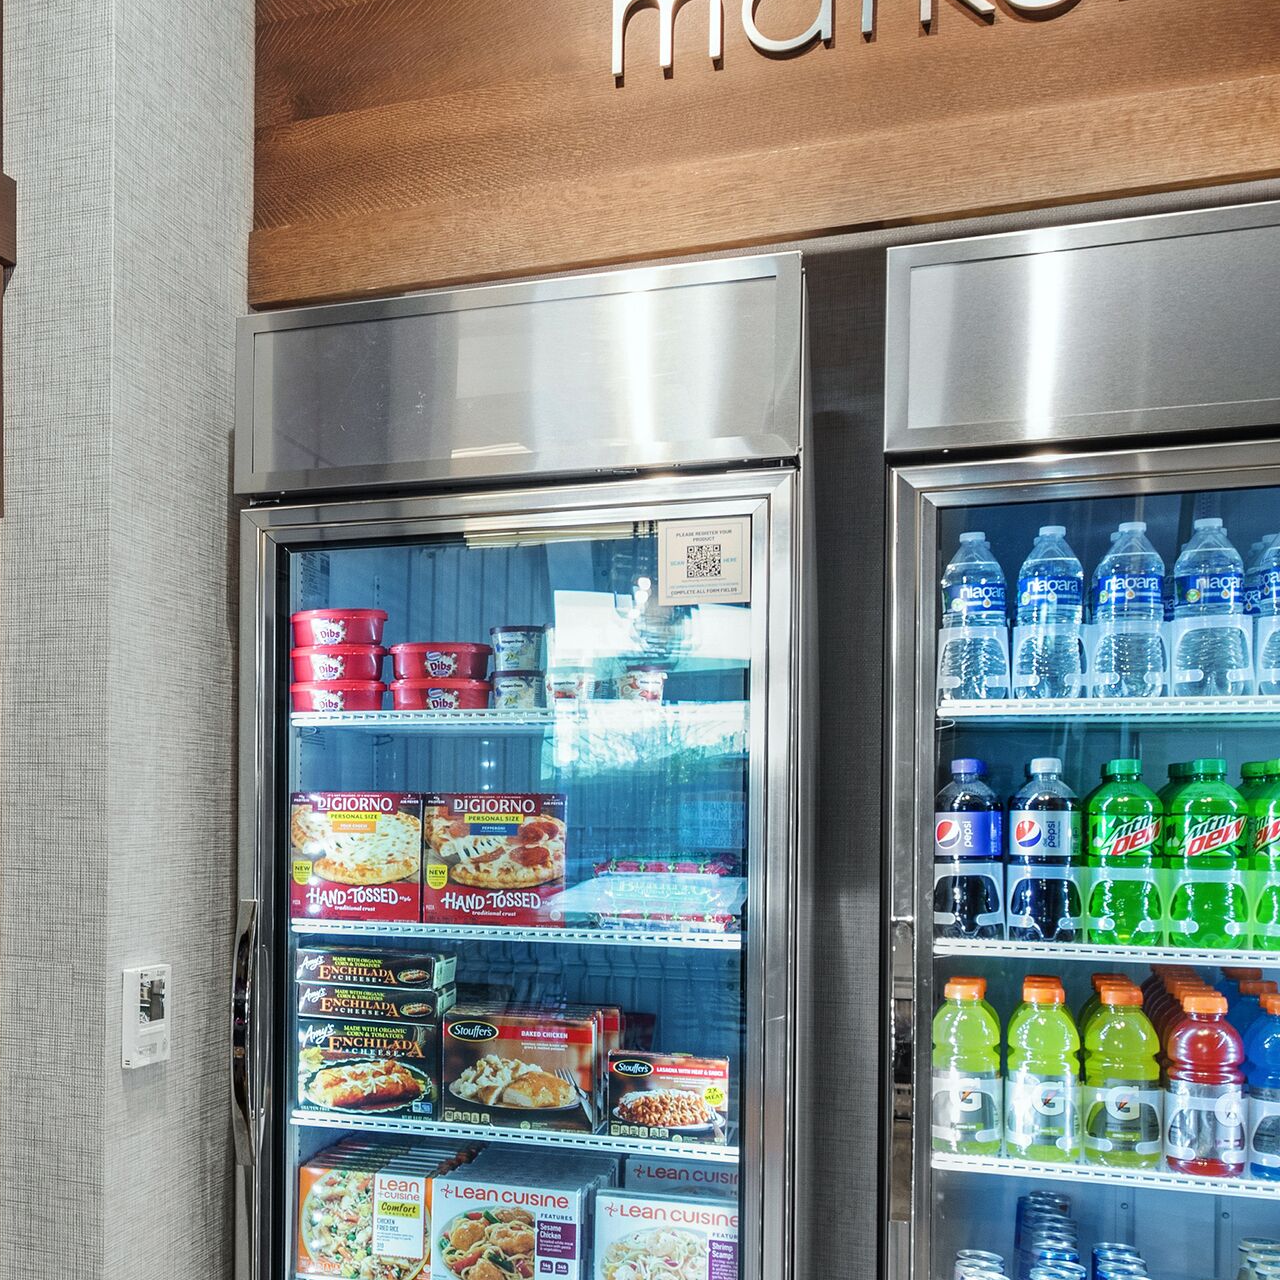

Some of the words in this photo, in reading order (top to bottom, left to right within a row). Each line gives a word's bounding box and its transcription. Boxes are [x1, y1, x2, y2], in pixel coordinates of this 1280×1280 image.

[1027, 579, 1078, 598] niagara
[1105, 576, 1159, 596] niagara
[429, 660, 452, 673] Dibs
[330, 812, 362, 820] PERSONAL
[963, 821, 973, 848] pepsi
[1046, 821, 1056, 848] pepsi
[299, 955, 325, 970] Amy's
[318, 965, 398, 984] ENCHILADA
[338, 974, 377, 983] CHEESE
[302, 987, 328, 1003] Amy's
[320, 997, 400, 1018] ENCHILADA
[340, 1007, 380, 1015] CHEESE
[302, 1024, 337, 1047] Amy's
[454, 1024, 493, 1039] Stouffer's
[328, 1036, 426, 1059] ENCHILADA
[351, 1047, 400, 1057] CHEESE
[618, 1062, 650, 1073] Stouffer's
[1031, 1082, 1065, 1116] G
[1105, 1086, 1139, 1120] G
[379, 1178, 419, 1193] Lean
[455, 1186, 498, 1202] Lean
[380, 1202, 417, 1214] Comfort
[620, 1205, 666, 1220] Lean
[540, 1213, 573, 1221] FEATURES
[540, 1223, 561, 1232] Sesame
[539, 1231, 561, 1240] Chicken
[712, 1243, 733, 1252] Shrimp
